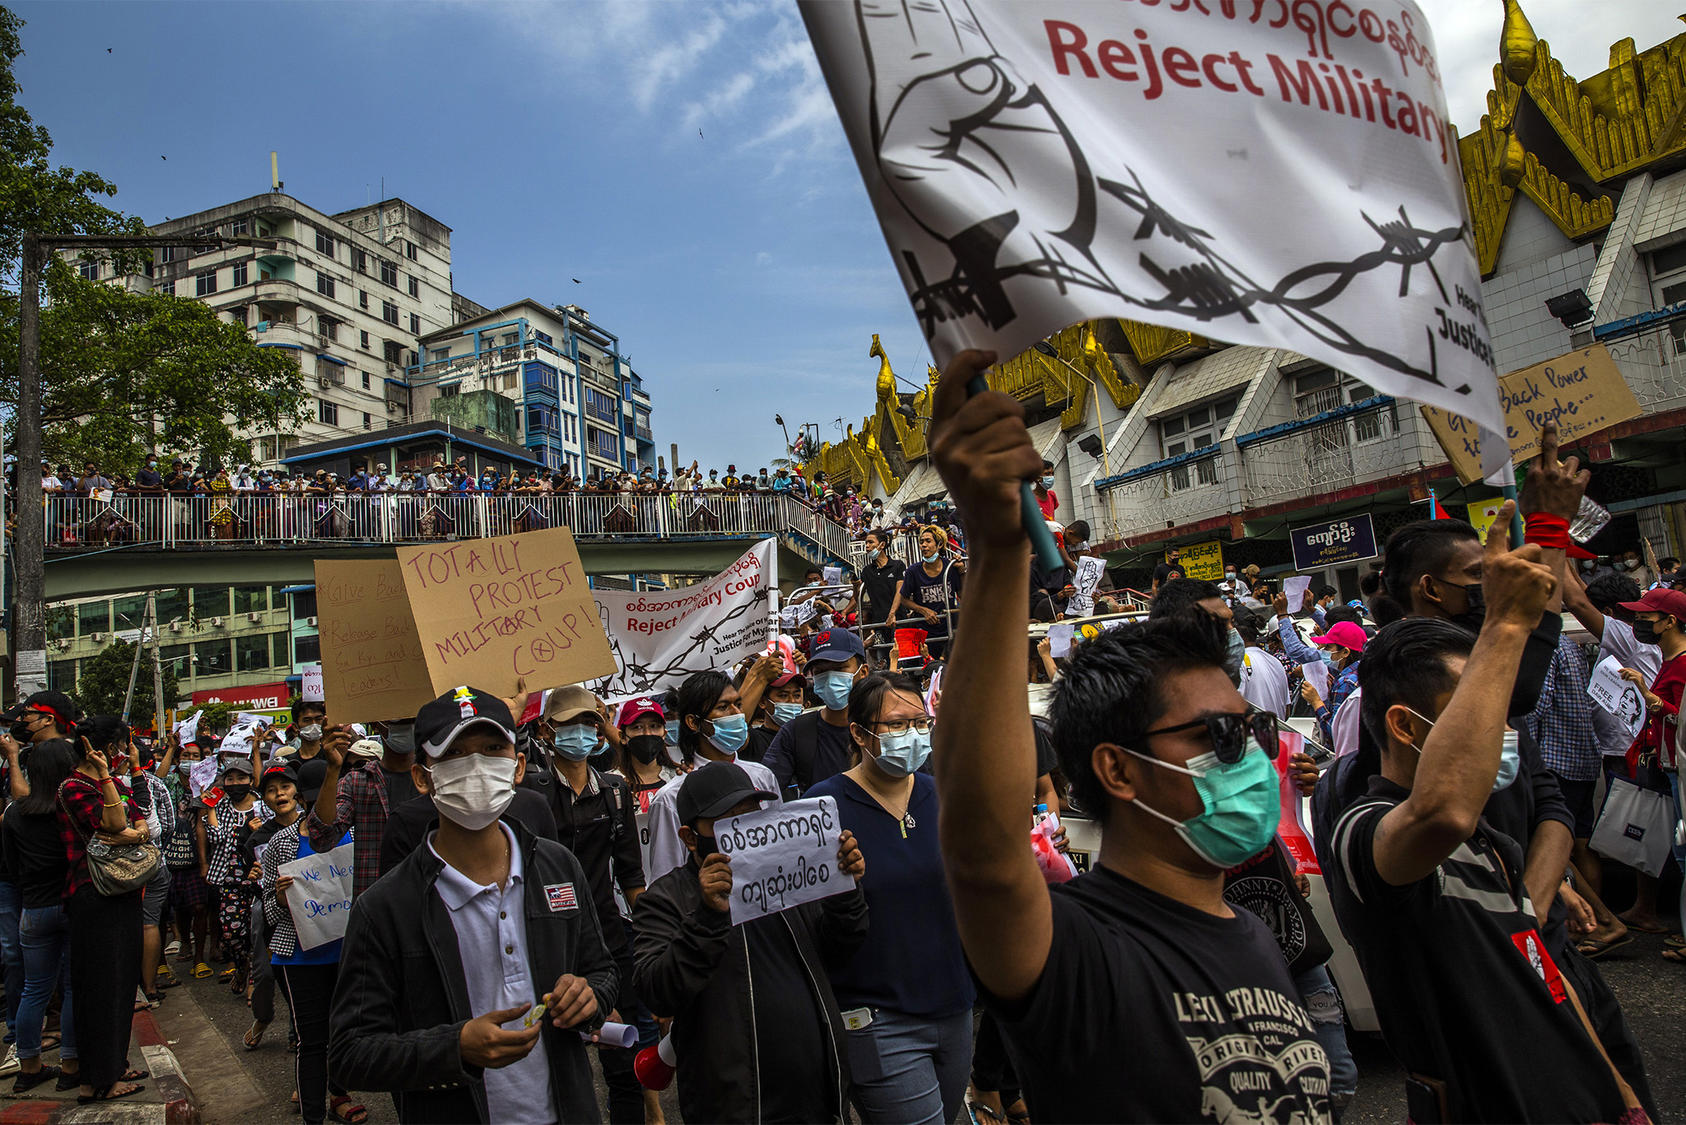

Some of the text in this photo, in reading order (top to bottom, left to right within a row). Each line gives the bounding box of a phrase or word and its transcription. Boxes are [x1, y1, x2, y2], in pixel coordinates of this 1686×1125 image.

[1043, 19, 1448, 165] Reject Military
[1545, 365, 1589, 390] Power
[407, 540, 522, 589] TOTALLY
[469, 561, 573, 619] PROTEST
[627, 616, 678, 636] Reject
[725, 573, 761, 596] Coup
[434, 605, 543, 665] MILITARY
[1594, 682, 1614, 703] FREE
[720, 799, 834, 854] စစ်အာဏာရှင်
[301, 867, 322, 882] We
[742, 855, 830, 913] ကျဆုံးပါစေ
[1255, 1021, 1300, 1037] FRANCISCO
[1230, 1071, 1272, 1095] QUALITY
